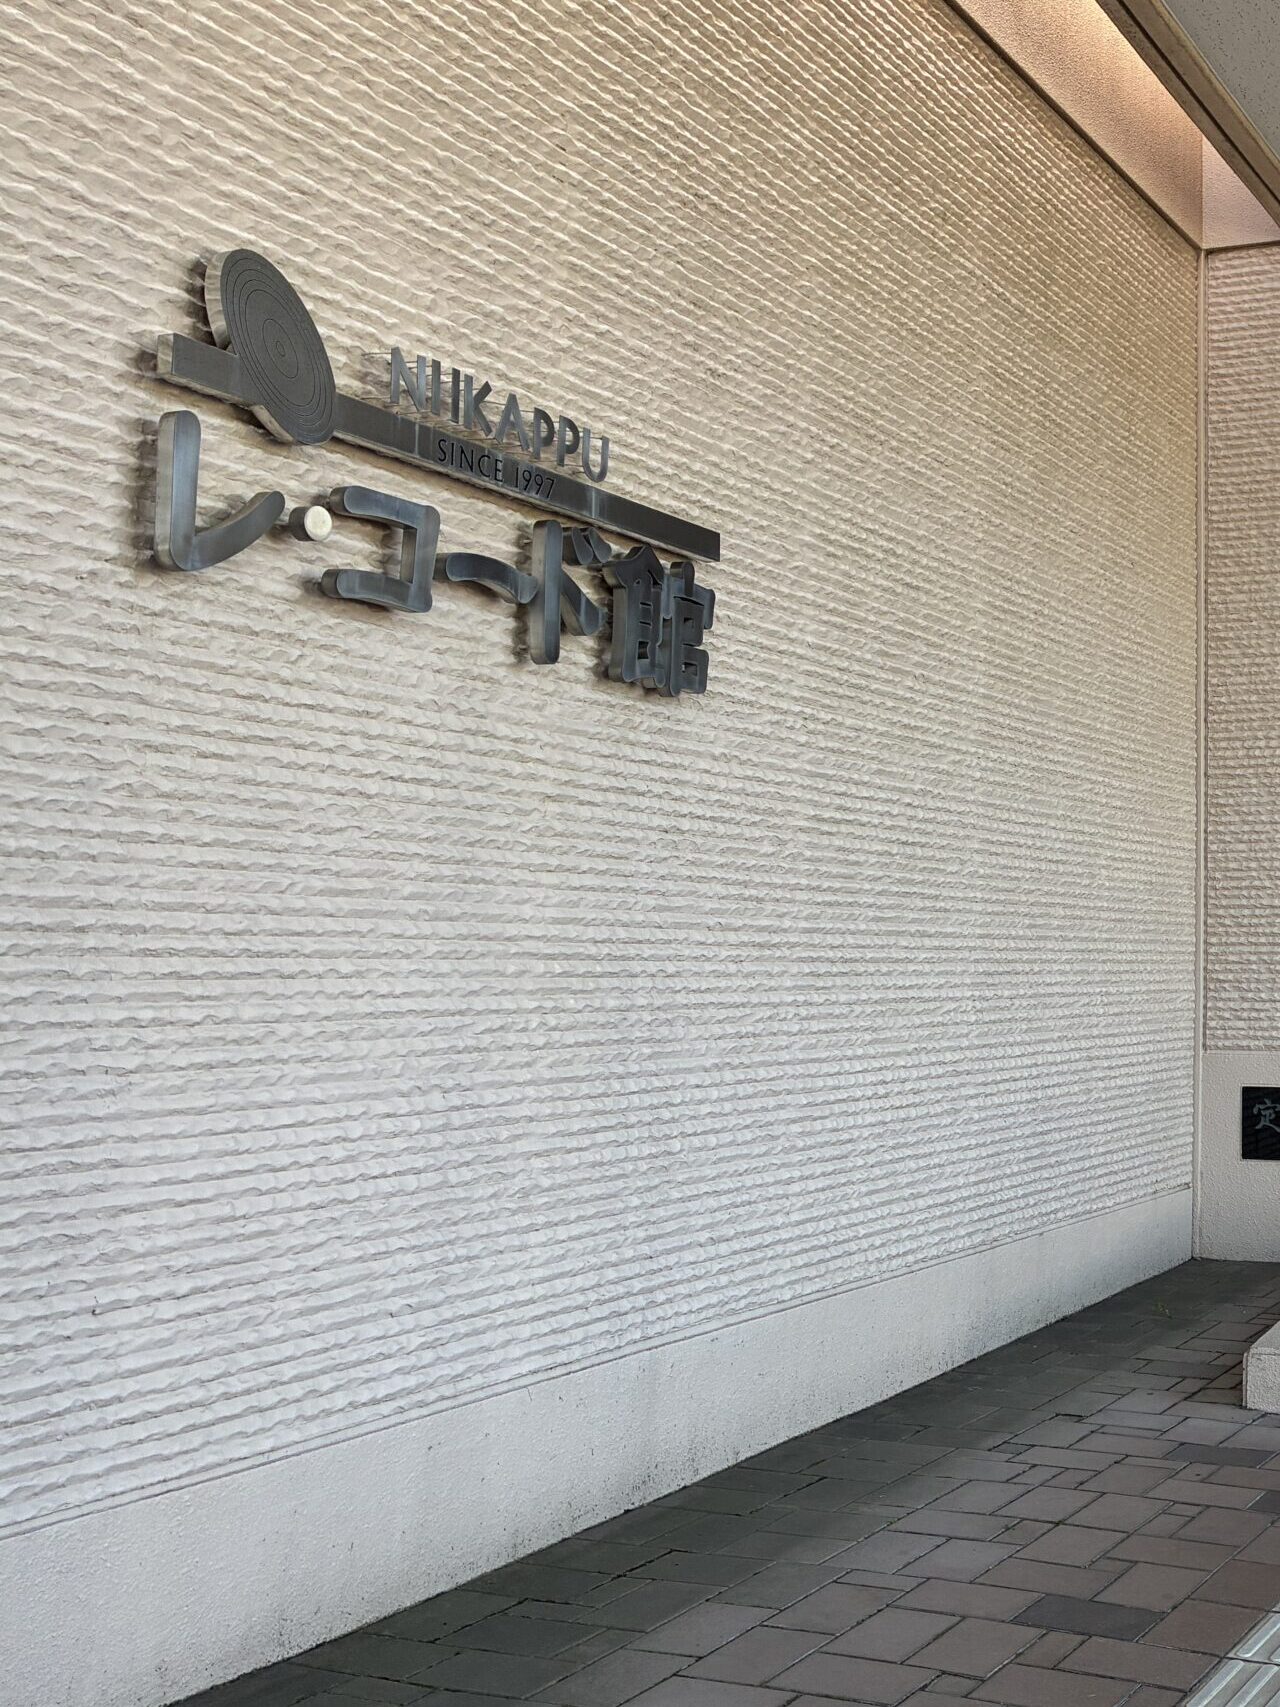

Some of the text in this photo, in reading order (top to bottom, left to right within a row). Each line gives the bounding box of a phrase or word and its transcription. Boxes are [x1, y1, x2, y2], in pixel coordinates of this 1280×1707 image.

[391, 346, 610, 484] NIIKAPPU
[437, 437, 556, 501] SINCE 1997
